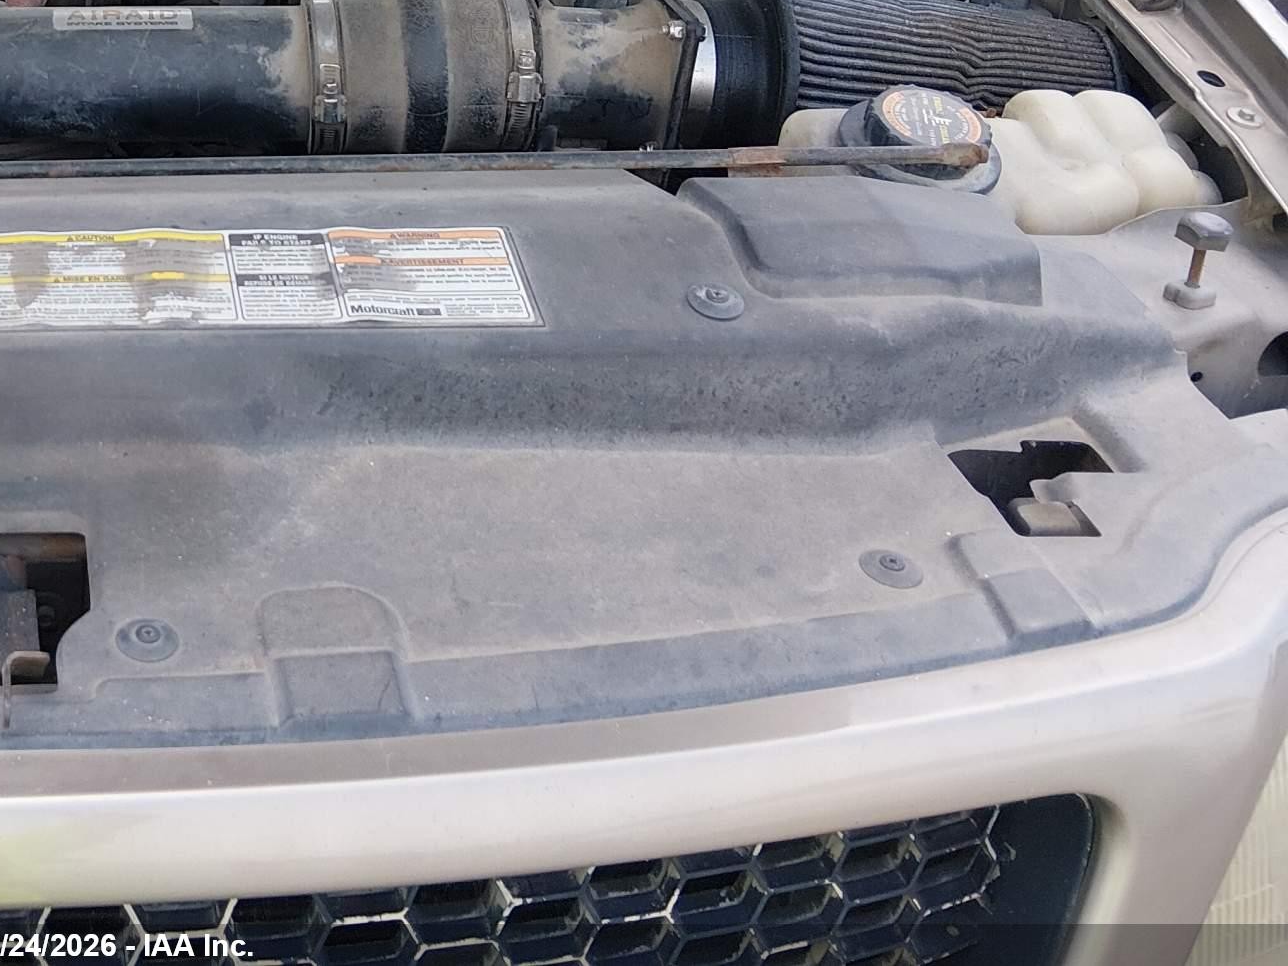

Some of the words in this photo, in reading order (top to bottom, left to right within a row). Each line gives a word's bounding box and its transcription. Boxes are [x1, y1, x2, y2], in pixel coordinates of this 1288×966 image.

[67, 9, 178, 20] AIRAID
[396, 231, 441, 239] WARNING
[350, 304, 416, 315] Motorcraft
